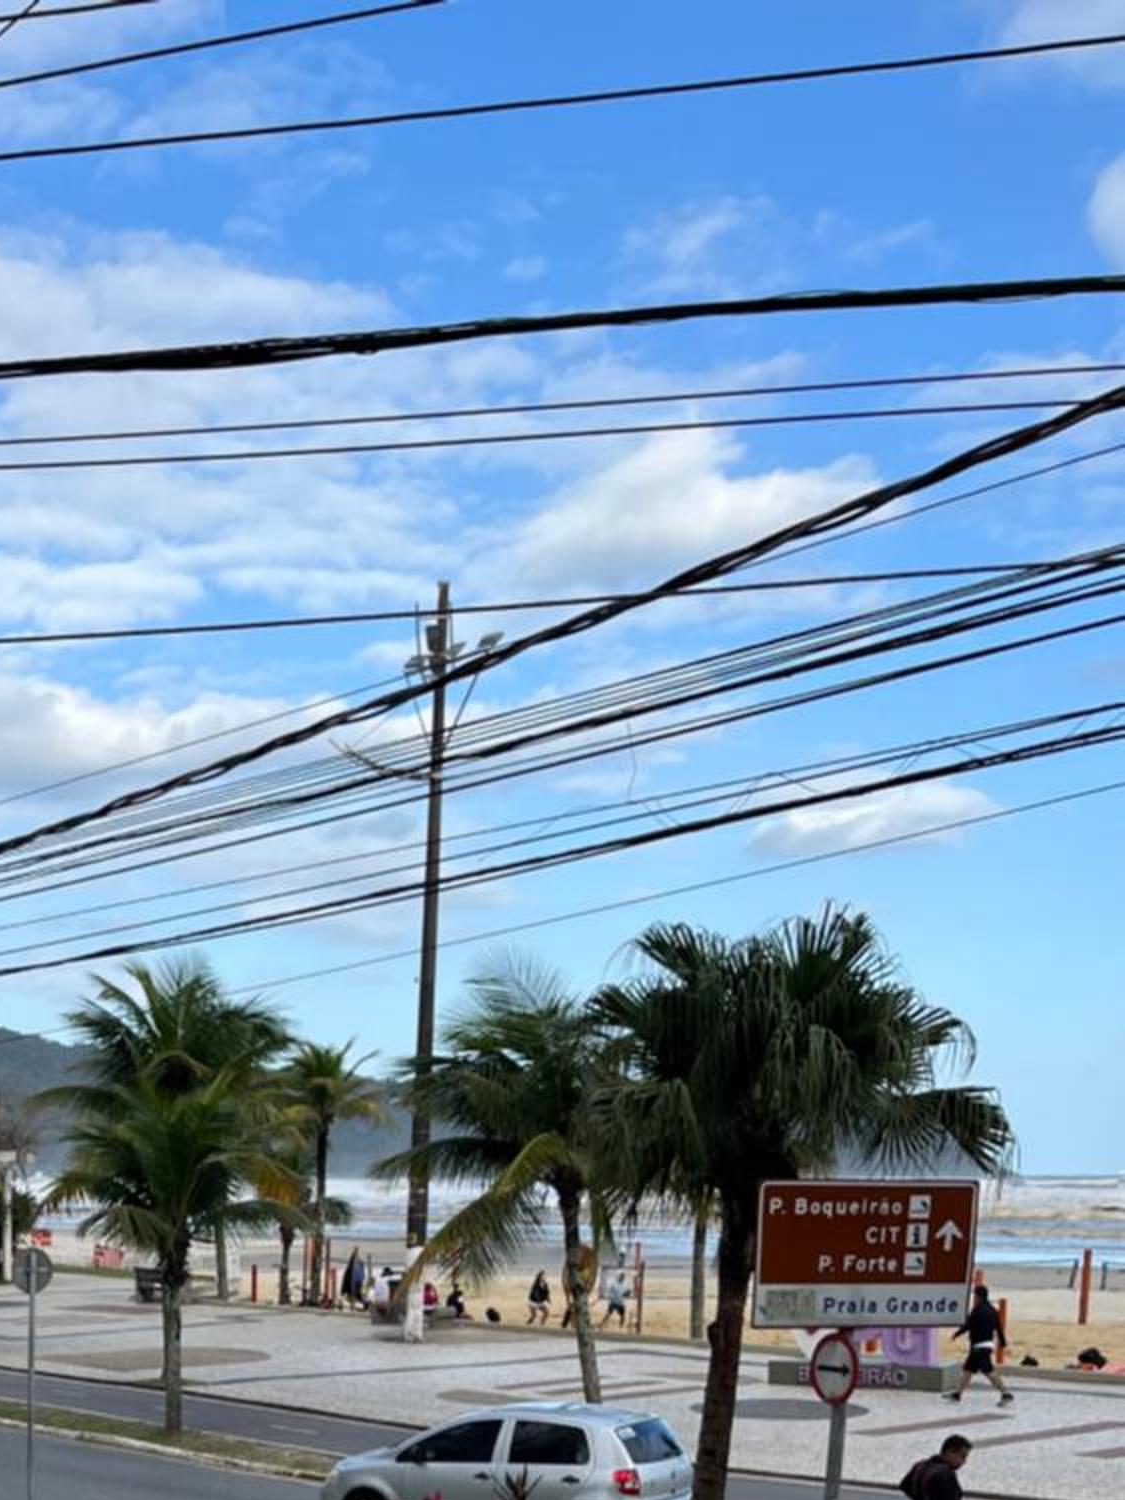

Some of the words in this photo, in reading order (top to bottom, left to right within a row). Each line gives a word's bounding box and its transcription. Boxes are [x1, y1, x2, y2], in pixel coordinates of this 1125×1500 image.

[768, 1198, 786, 1215] P.
[795, 1197, 902, 1218] Boqueirão
[865, 1226, 901, 1243] CIT
[818, 1255, 835, 1272] P.
[842, 1254, 897, 1272] Forte
[823, 1297, 877, 1313] Praia
[886, 1297, 958, 1313] Grande
[797, 1364, 908, 1386] BIRÃO
